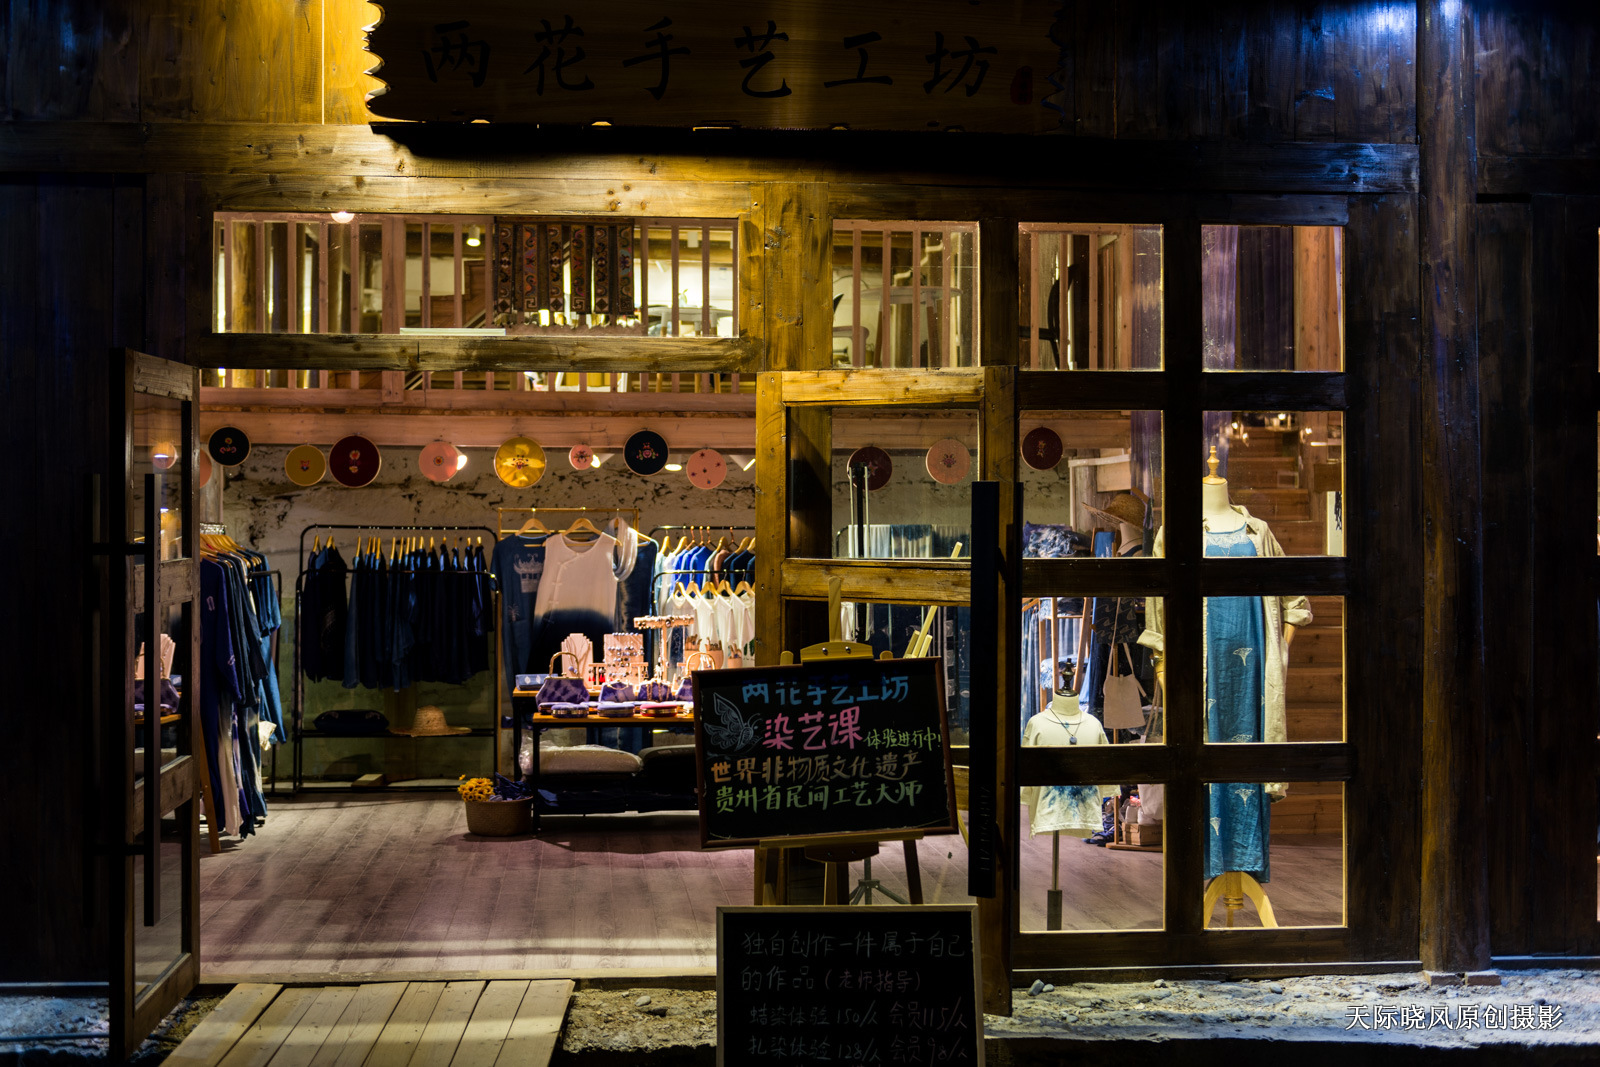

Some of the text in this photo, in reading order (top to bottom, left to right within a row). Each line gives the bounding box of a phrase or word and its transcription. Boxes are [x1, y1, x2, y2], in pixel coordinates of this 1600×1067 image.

[422, 14, 998, 101] 两花手艺工坊
[761, 706, 863, 751] 染艺课
[711, 750, 923, 785] 世界非物质文化遗产
[715, 781, 923, 814] 贵州省民间工艺大师
[742, 931, 966, 958] 独自创作一件属于自己
